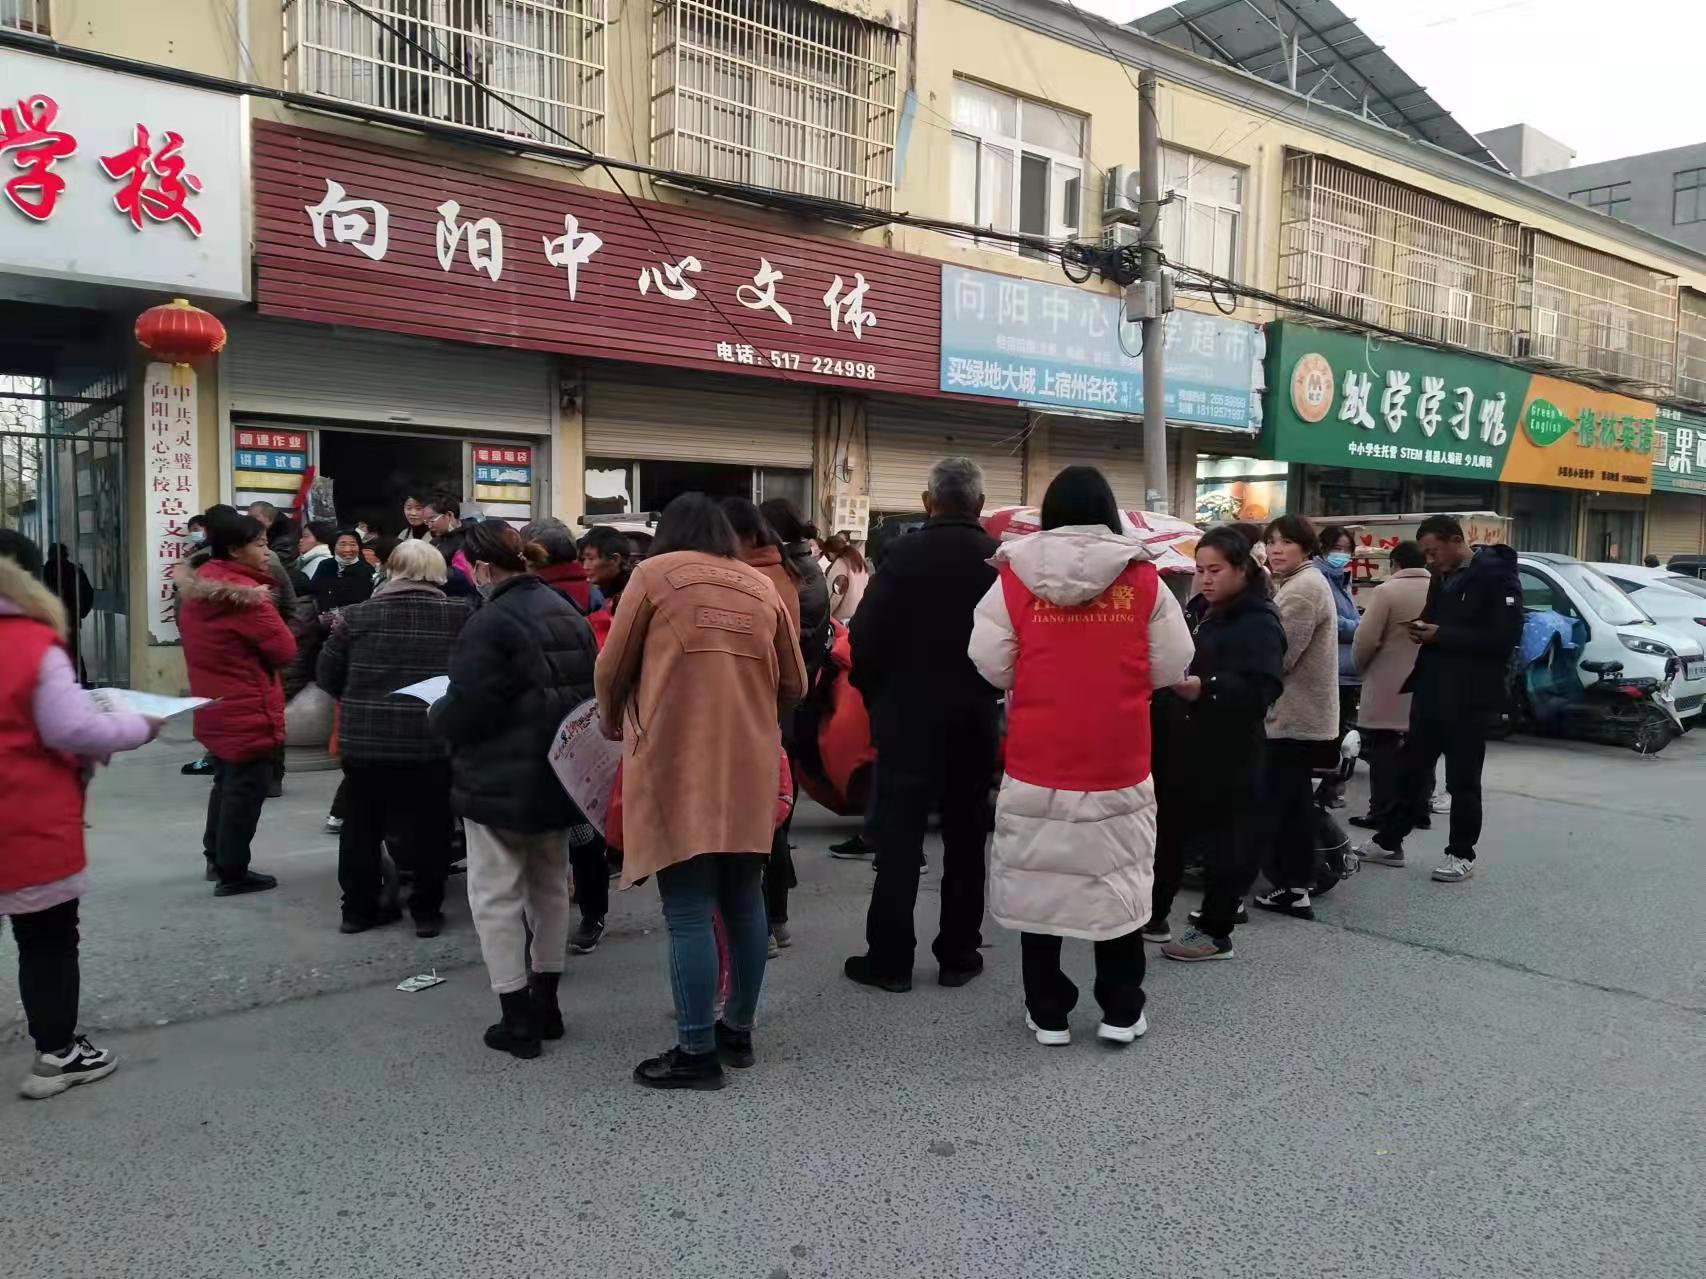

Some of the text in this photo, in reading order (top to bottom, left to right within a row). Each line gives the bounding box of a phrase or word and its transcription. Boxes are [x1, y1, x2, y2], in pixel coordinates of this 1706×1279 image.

[0, 93, 203, 237] 学校
[305, 178, 877, 339] 向阳中心文体
[717, 342, 876, 380] 电话： 517 224998
[947, 357, 1036, 394] 买绿地大城
[1039, 368, 1118, 404] 上宿州名校
[1530, 418, 1562, 433] English
[1531, 405, 1556, 419] Green
[151, 382, 170, 492] 向阳中心学校
[173, 385, 192, 492] 中共灵璧县
[1348, 441, 1493, 468] 中小学生托管 STEM 机器人编程 少儿阅读
